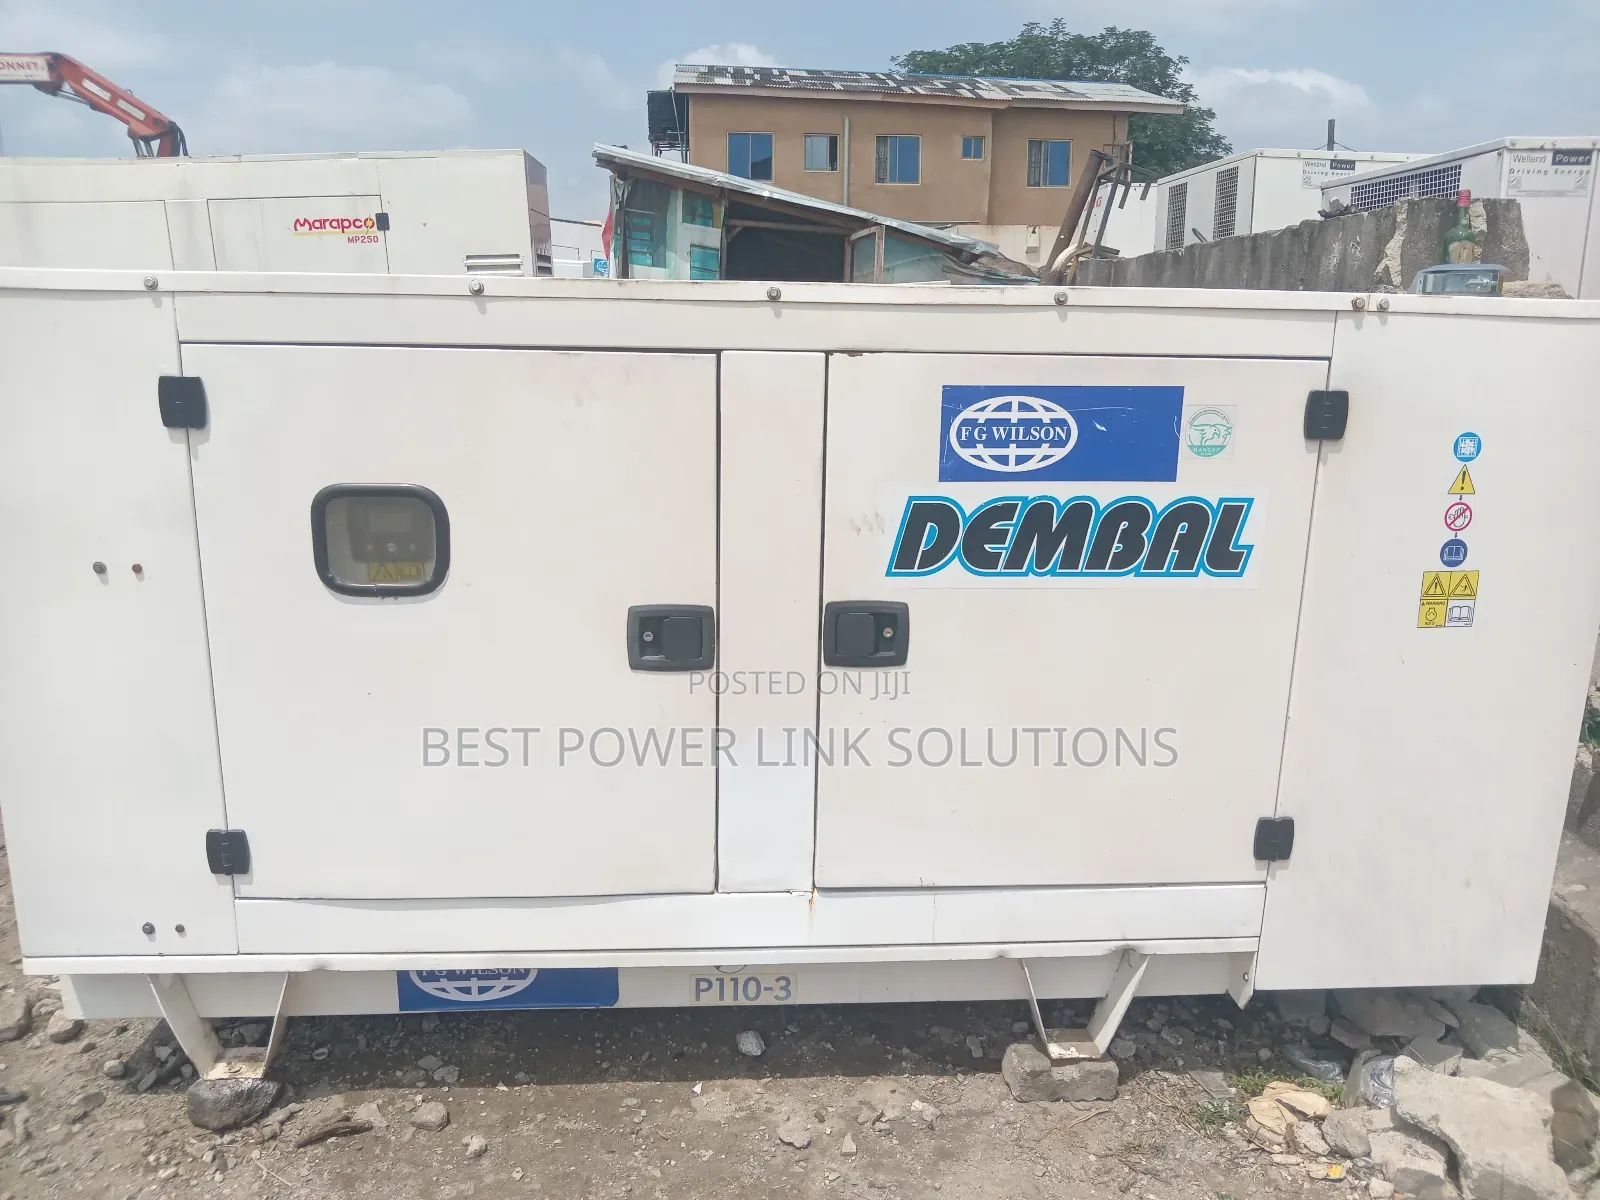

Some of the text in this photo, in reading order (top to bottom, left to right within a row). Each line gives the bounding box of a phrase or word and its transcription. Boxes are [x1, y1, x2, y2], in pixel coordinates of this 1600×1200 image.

[1513, 154, 1591, 163] Welland Power
[1509, 168, 1591, 176] Driving Energy
[294, 216, 376, 234] Marapco
[347, 235, 379, 244] MP250
[960, 426, 1068, 441] FG WILSON
[886, 495, 1254, 577] DEMBAL
[695, 975, 792, 1002] P110-3
